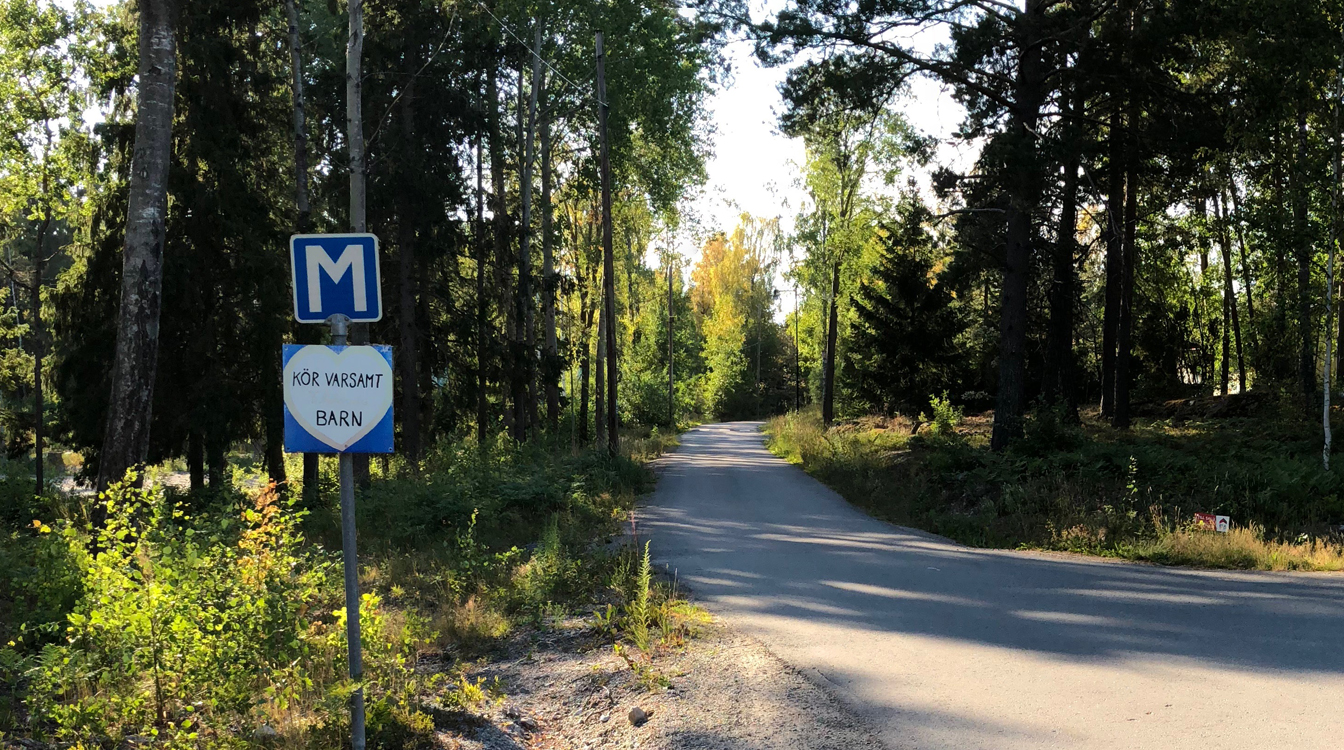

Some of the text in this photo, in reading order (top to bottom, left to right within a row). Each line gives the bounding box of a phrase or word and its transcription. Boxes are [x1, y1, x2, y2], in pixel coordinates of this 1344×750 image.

[305, 244, 367, 313] M
[292, 368, 383, 388] KÖR VARSAMT
[316, 410, 363, 427] BARN
